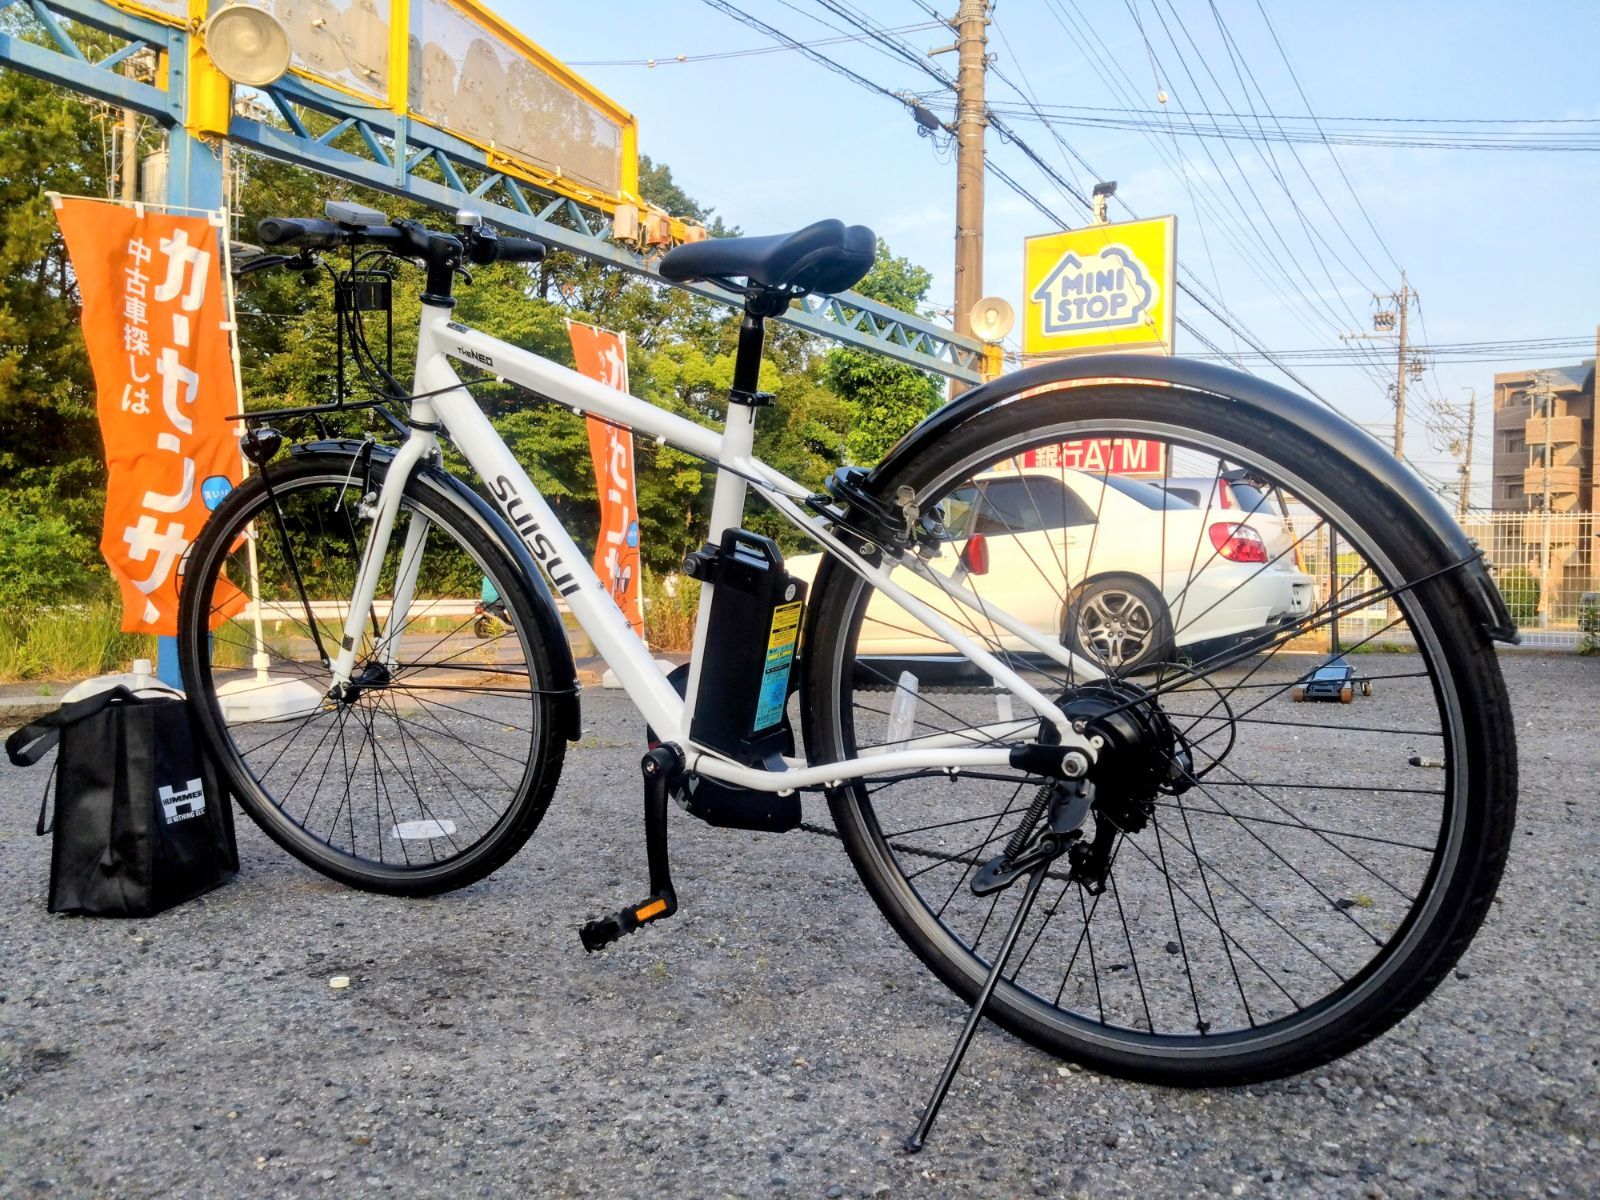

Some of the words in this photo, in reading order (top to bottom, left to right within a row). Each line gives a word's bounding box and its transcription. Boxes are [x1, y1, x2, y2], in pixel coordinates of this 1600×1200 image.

[1061, 267, 1124, 298] MINI
[1057, 293, 1128, 323] STOP
[122, 237, 151, 415] 中古車探しは
[488, 475, 582, 598] SUISUI
[162, 790, 203, 806] HUMMER
